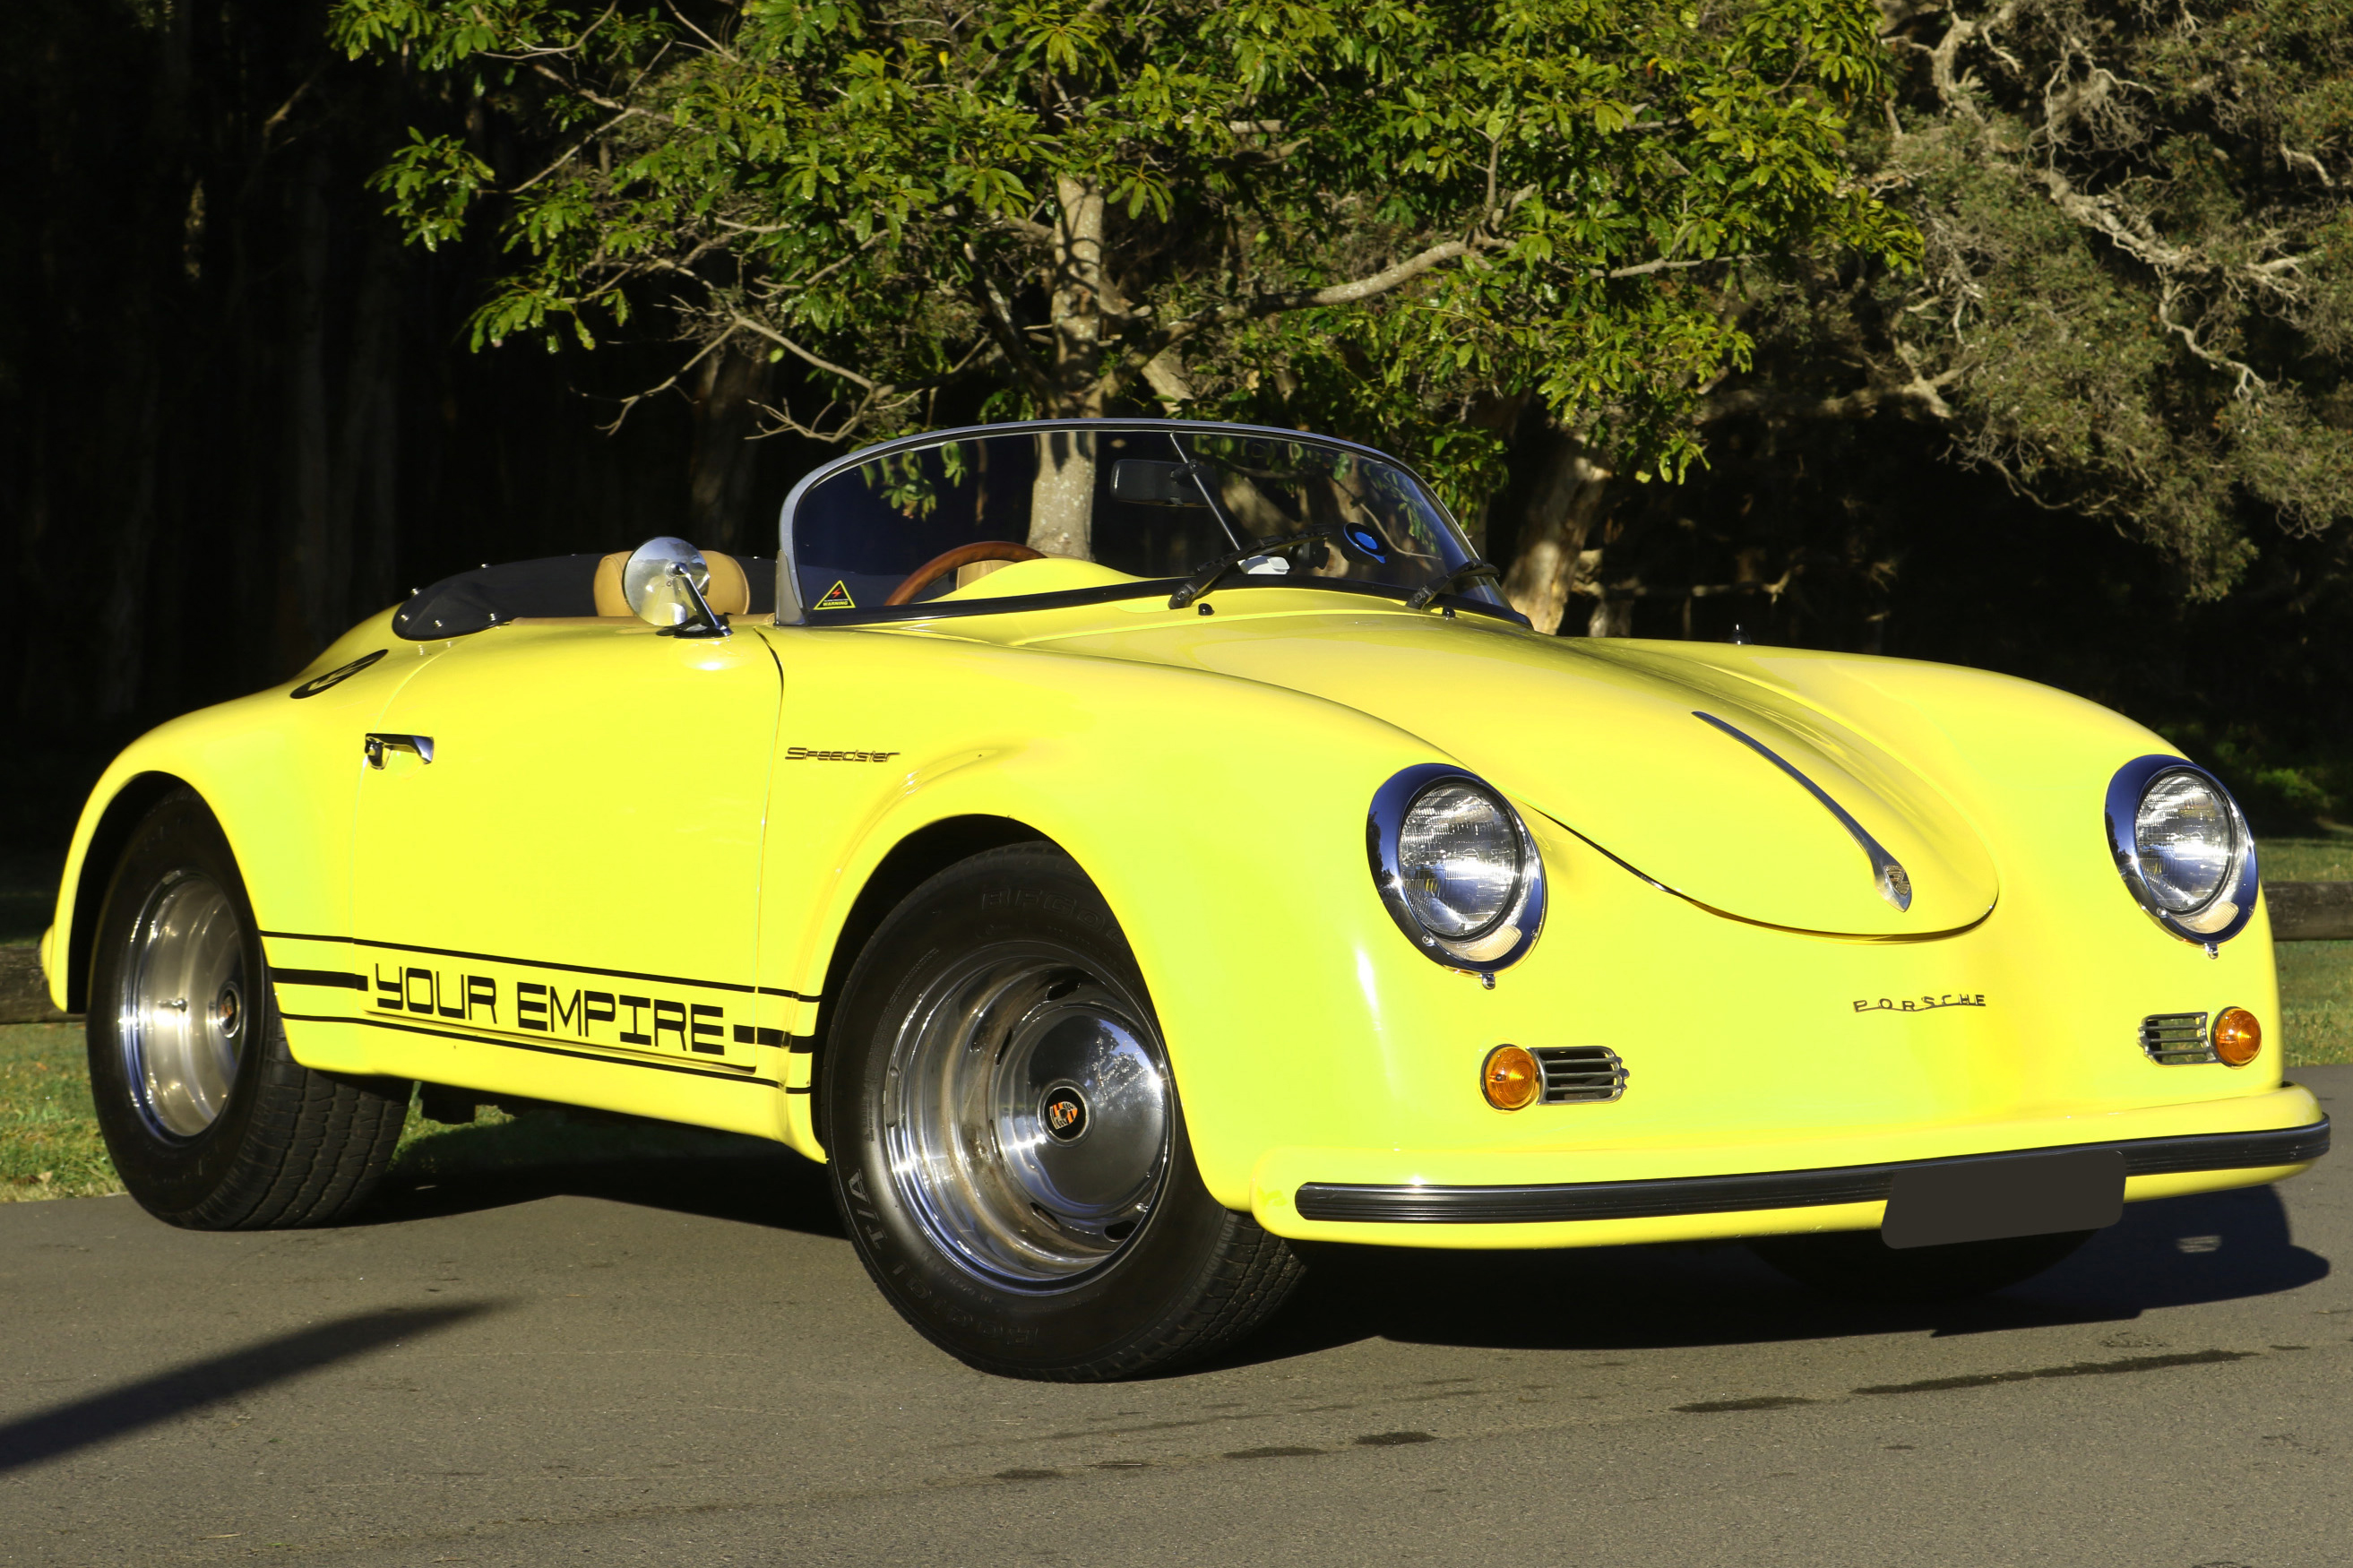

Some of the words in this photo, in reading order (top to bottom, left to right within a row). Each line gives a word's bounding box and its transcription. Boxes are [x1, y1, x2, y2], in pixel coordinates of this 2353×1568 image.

[785, 746, 901, 762] Speedster
[375, 962, 497, 1024] YOUR
[516, 981, 726, 1055] EMPIRE
[1852, 993, 1987, 1012] PORSCHE
[848, 1167, 888, 1251] T/A
